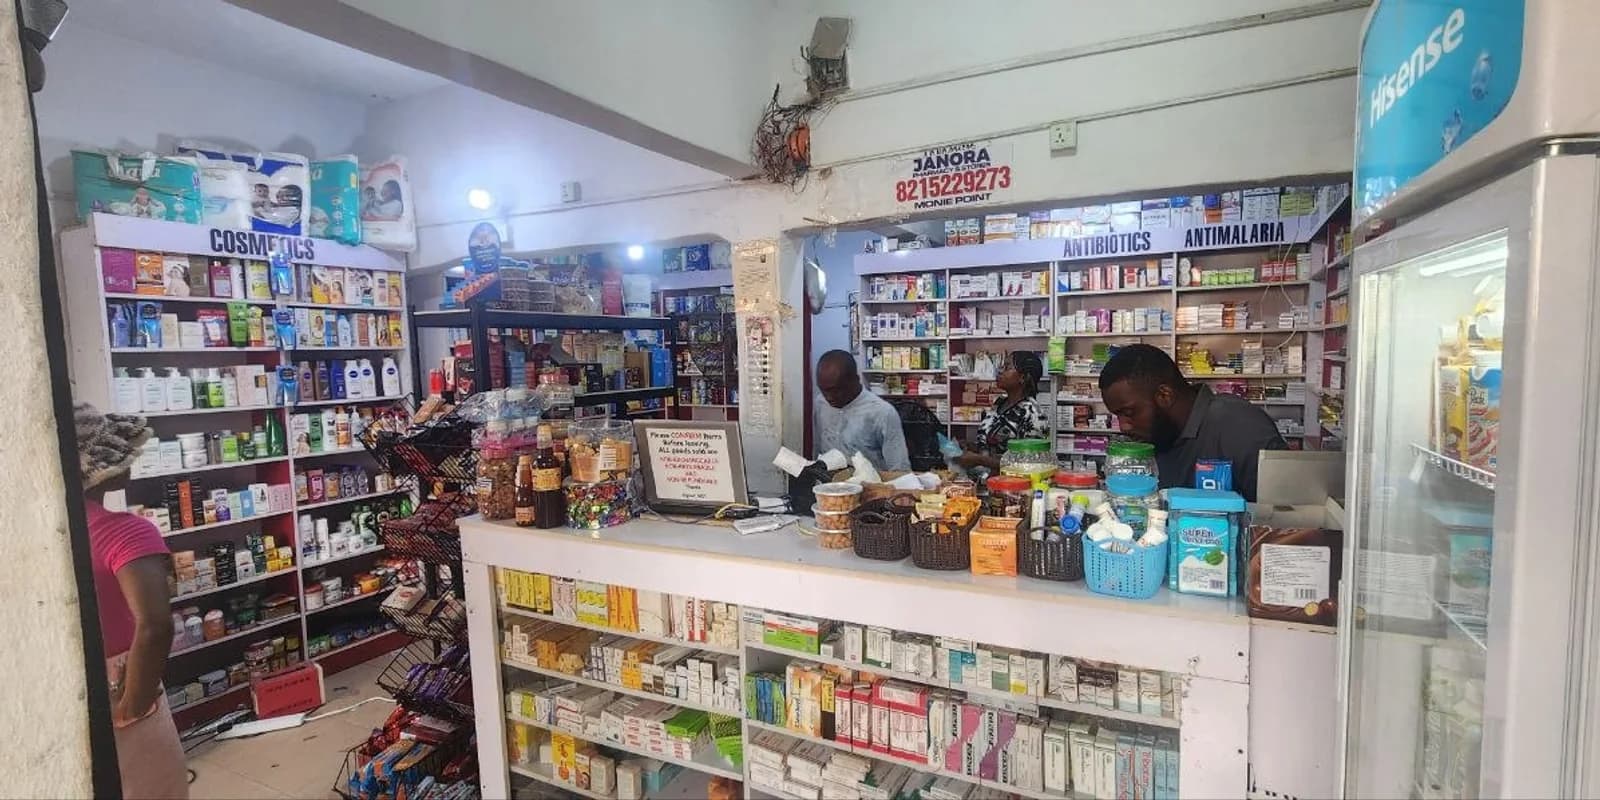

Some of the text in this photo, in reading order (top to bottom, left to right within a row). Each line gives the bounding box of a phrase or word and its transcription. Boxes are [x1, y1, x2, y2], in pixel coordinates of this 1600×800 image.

[1370, 8, 1465, 128] Hisense
[913, 147, 990, 172] JANORA
[896, 166, 1011, 202] 8215229273
[955, 193, 992, 204] POINT
[1063, 231, 1151, 258] ANTIBIOTICS
[1184, 222, 1285, 248] ANTIMALARIA
